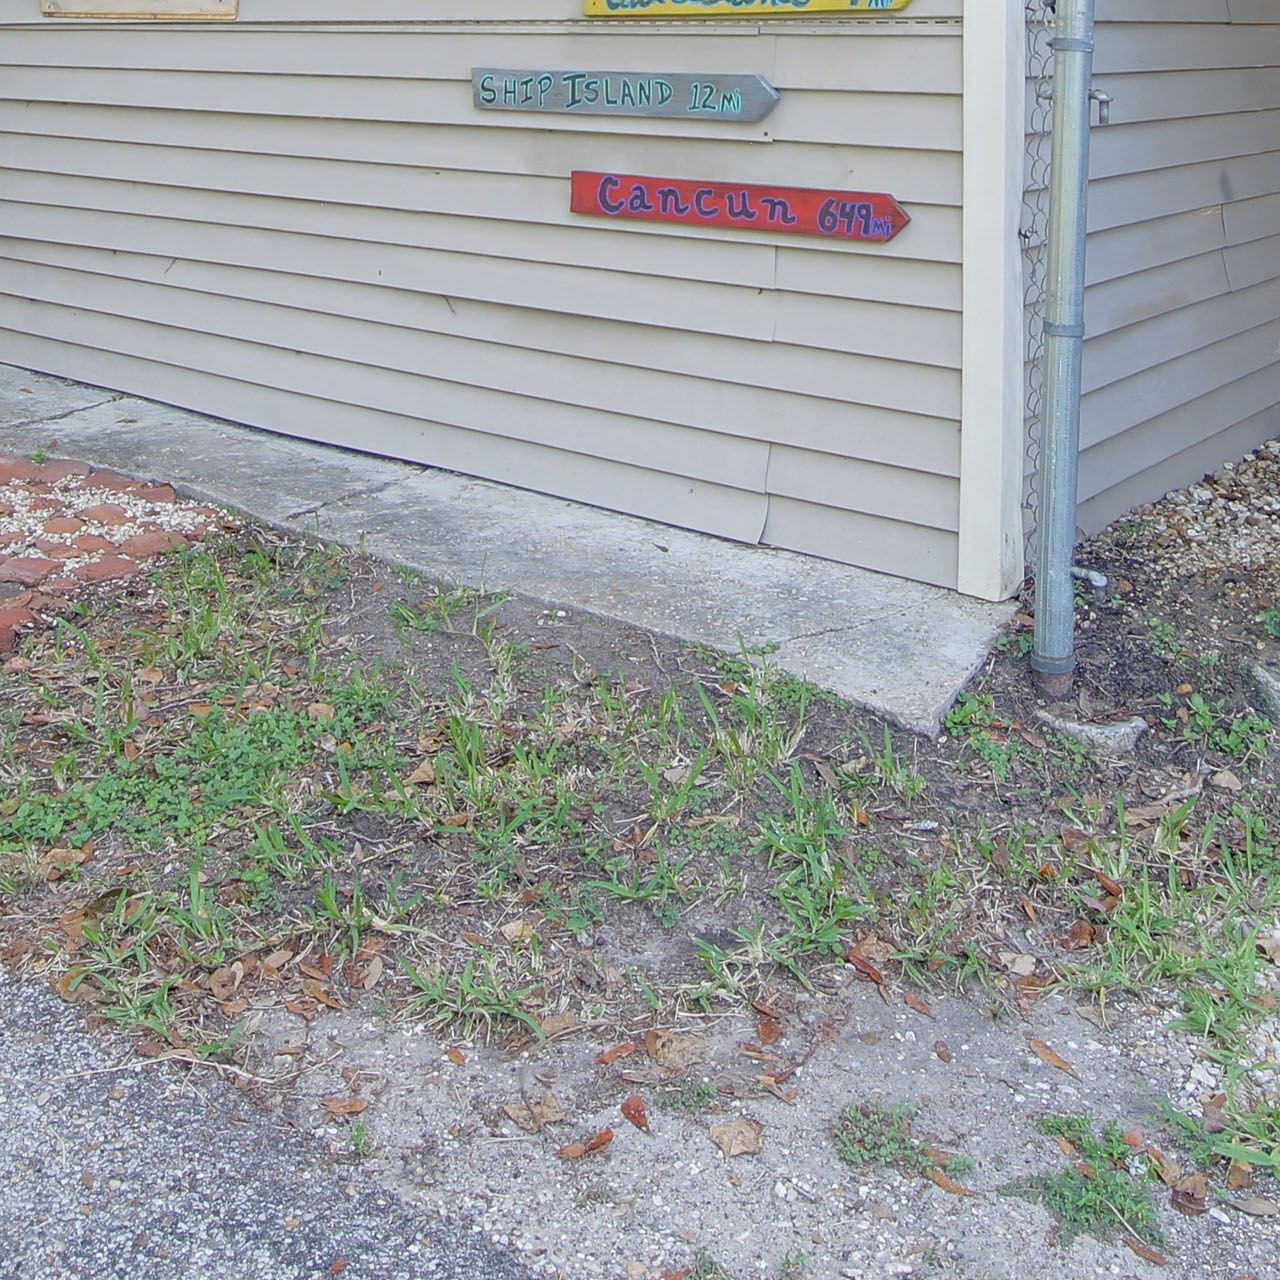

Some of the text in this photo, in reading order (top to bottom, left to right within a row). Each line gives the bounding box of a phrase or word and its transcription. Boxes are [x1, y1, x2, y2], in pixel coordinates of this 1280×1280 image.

[479, 73, 553, 108] SHIP
[562, 73, 674, 109] ISLAND
[687, 82, 718, 111] 12
[597, 175, 798, 224] Cancun
[817, 196, 872, 237] 649
